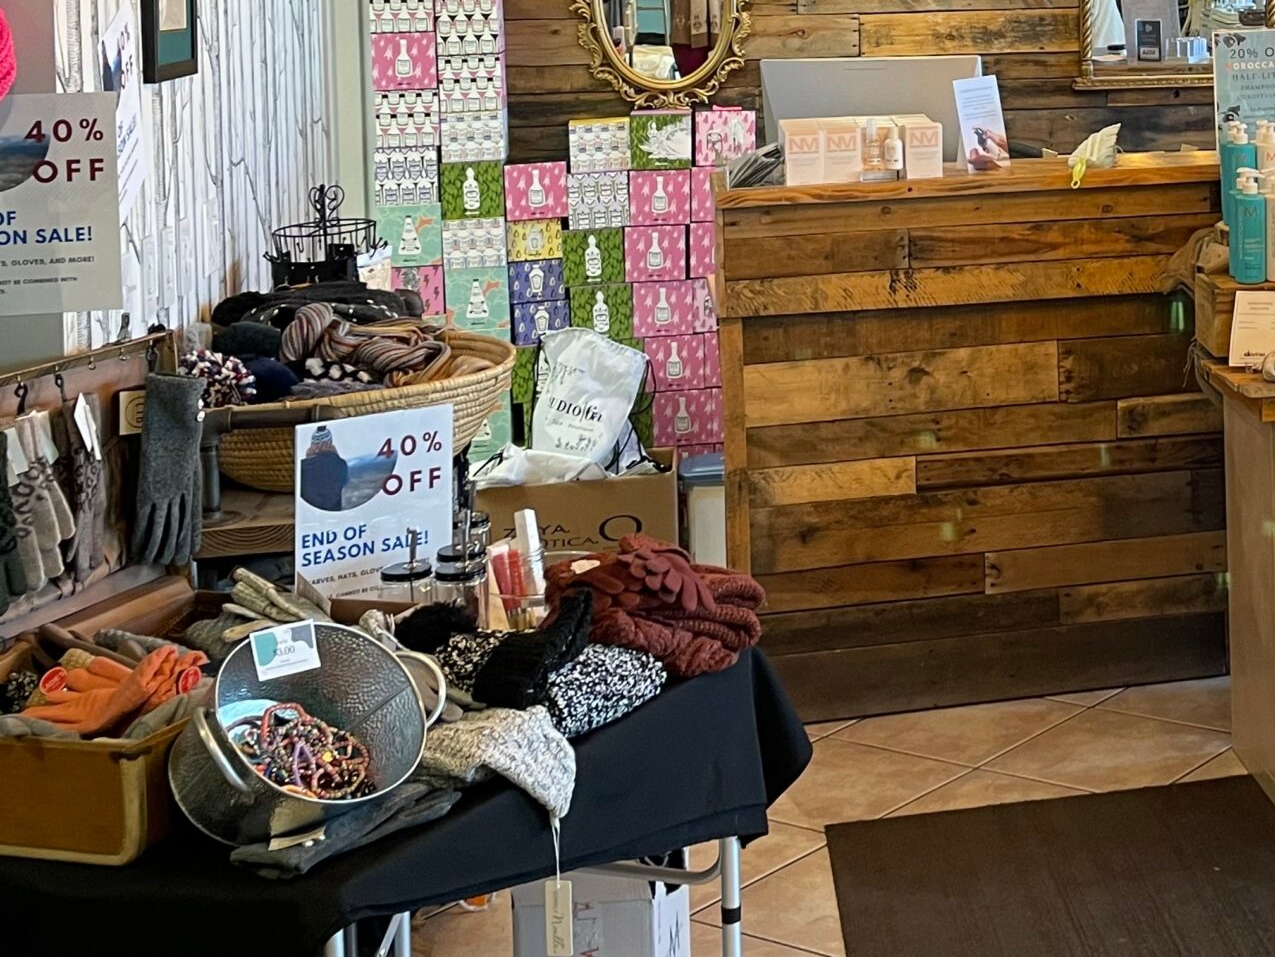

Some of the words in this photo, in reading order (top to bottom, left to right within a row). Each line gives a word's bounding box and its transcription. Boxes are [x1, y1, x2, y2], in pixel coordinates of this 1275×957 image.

[1230, 47, 1259, 59] 20%
[25, 118, 104, 142] 40%
[909, 130, 939, 146] NM
[788, 137, 819, 151] NM
[827, 135, 857, 150] NM
[33, 158, 104, 183] OFF
[35, 226, 93, 244] SALE!
[376, 430, 443, 459] 40%
[382, 466, 442, 495] OFF
[302, 530, 337, 549] END
[343, 523, 367, 541] OF
[504, 524, 569, 539] ZYA
[301, 540, 376, 567] SEASON
[380, 529, 429, 553] SALE!
